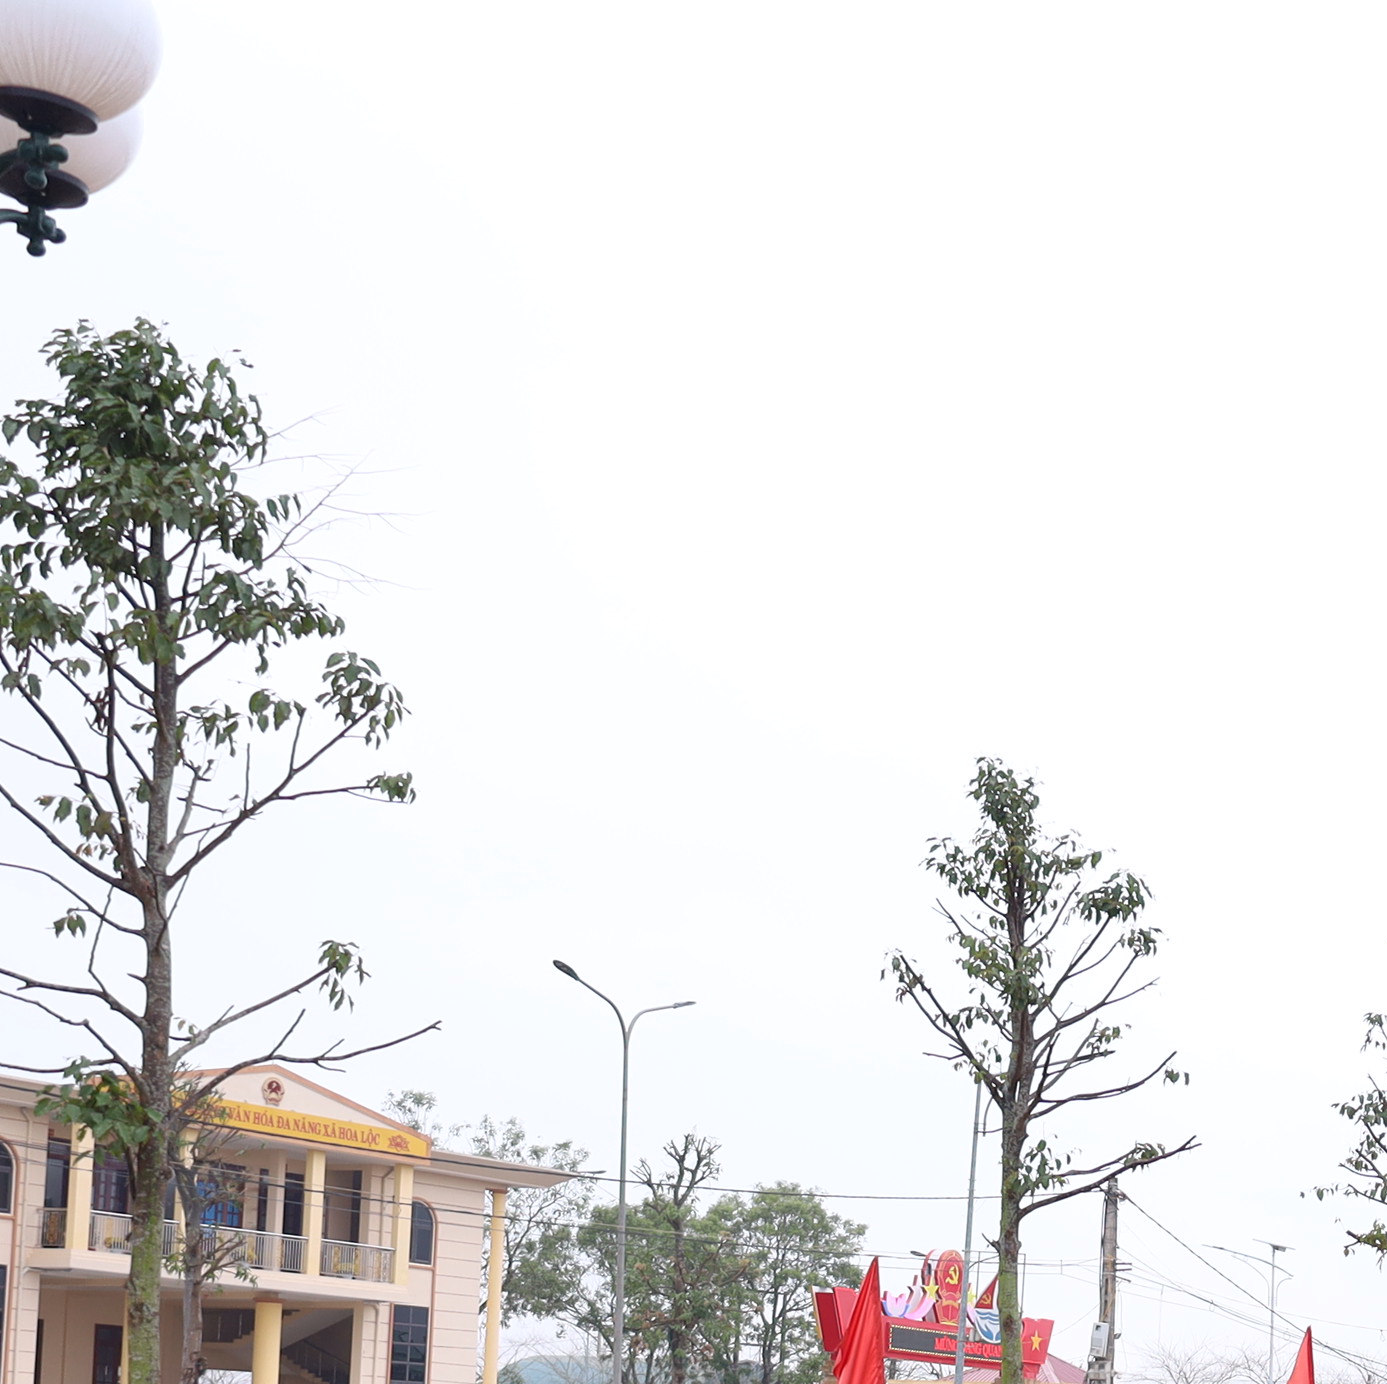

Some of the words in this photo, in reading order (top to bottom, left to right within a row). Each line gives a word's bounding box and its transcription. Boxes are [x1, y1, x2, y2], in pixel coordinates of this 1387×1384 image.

[253, 1110, 275, 1127] HÓA
[276, 1115, 291, 1130] ĐA
[292, 1117, 322, 1136] NĂNG
[338, 1127, 359, 1142] HOA
[361, 1128, 381, 1147] LỘC
